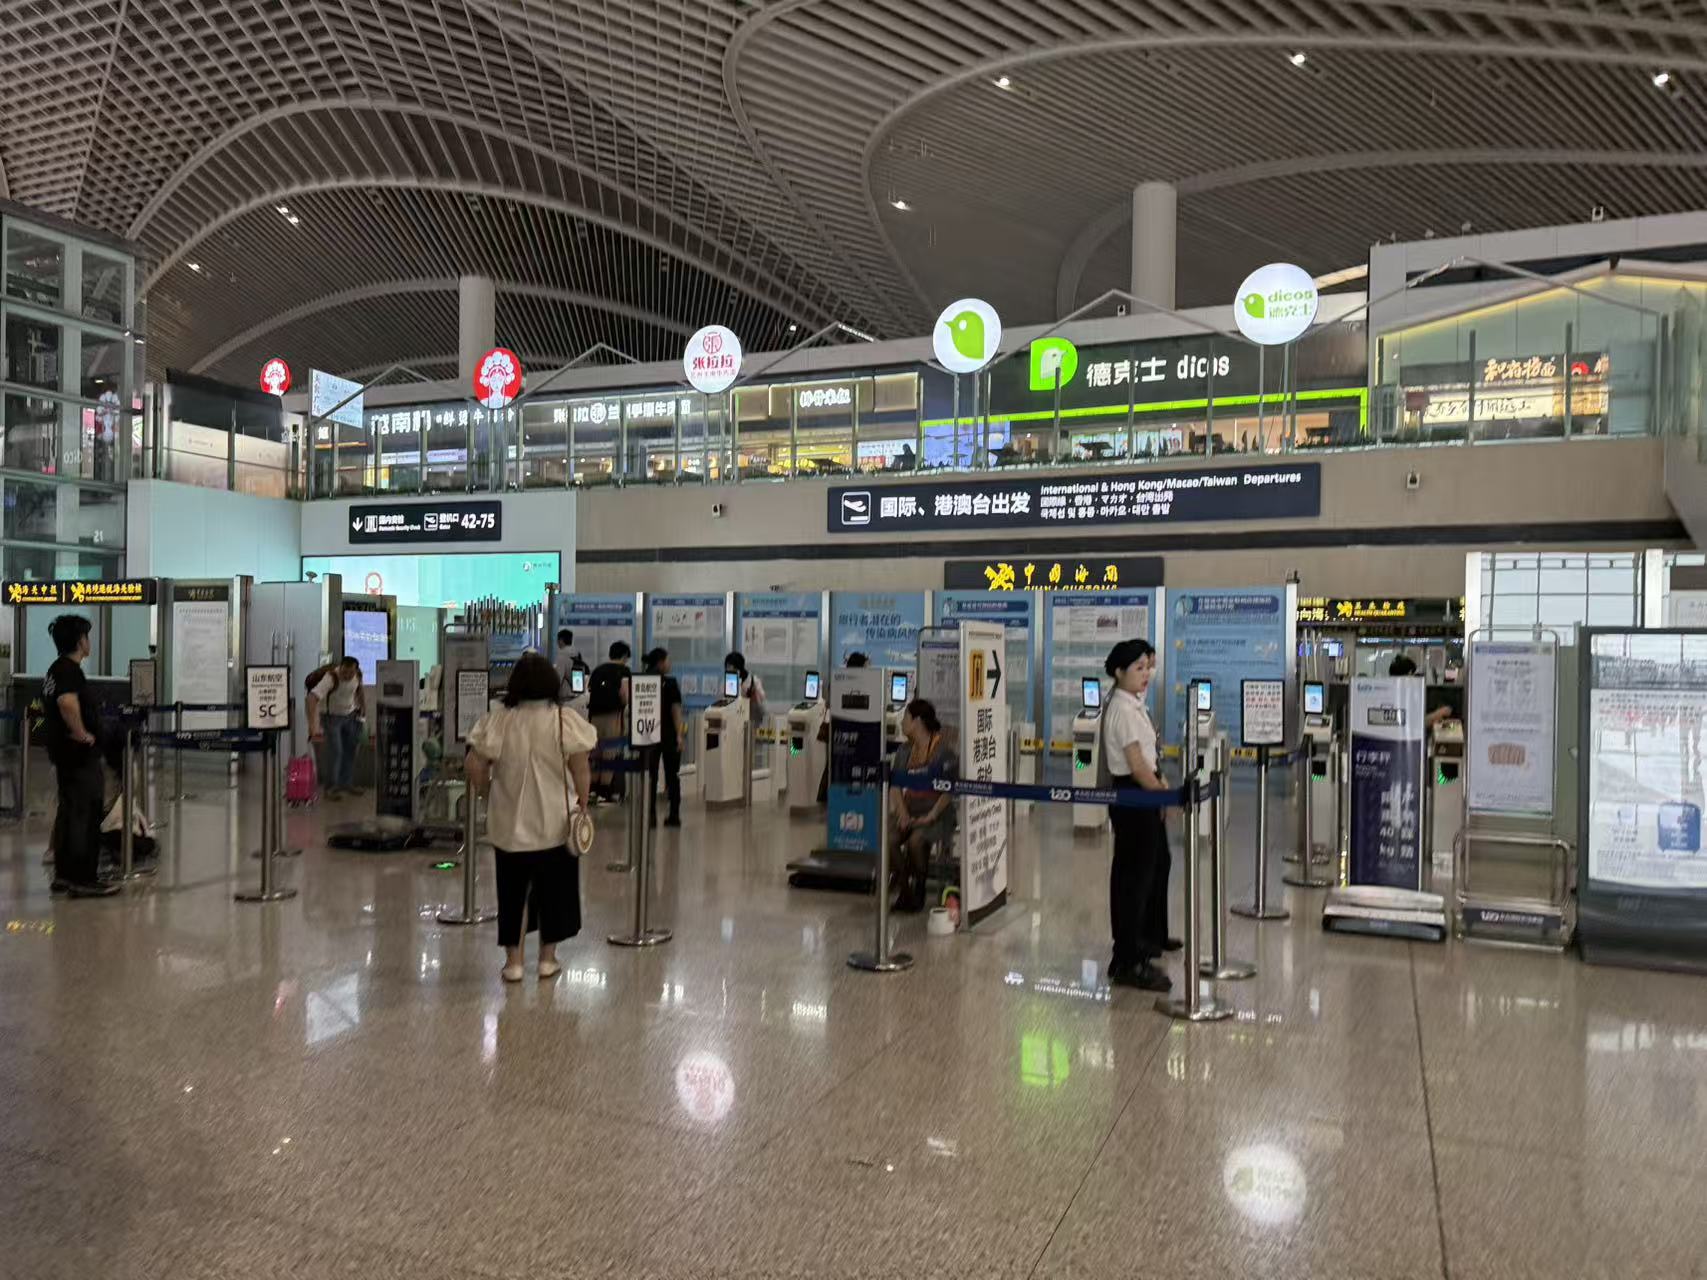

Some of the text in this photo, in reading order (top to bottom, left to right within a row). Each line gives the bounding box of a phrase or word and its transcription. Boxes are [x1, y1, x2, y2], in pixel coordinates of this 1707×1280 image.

[1268, 290, 1313, 303] dicos
[1040, 472, 1302, 495] International & Hong Kong/Macao/Taiwan Departures
[880, 491, 1031, 518] 国际、港澳台出发
[461, 513, 495, 529] 42-75
[259, 704, 277, 718] SC
[636, 718, 656, 736] QW
